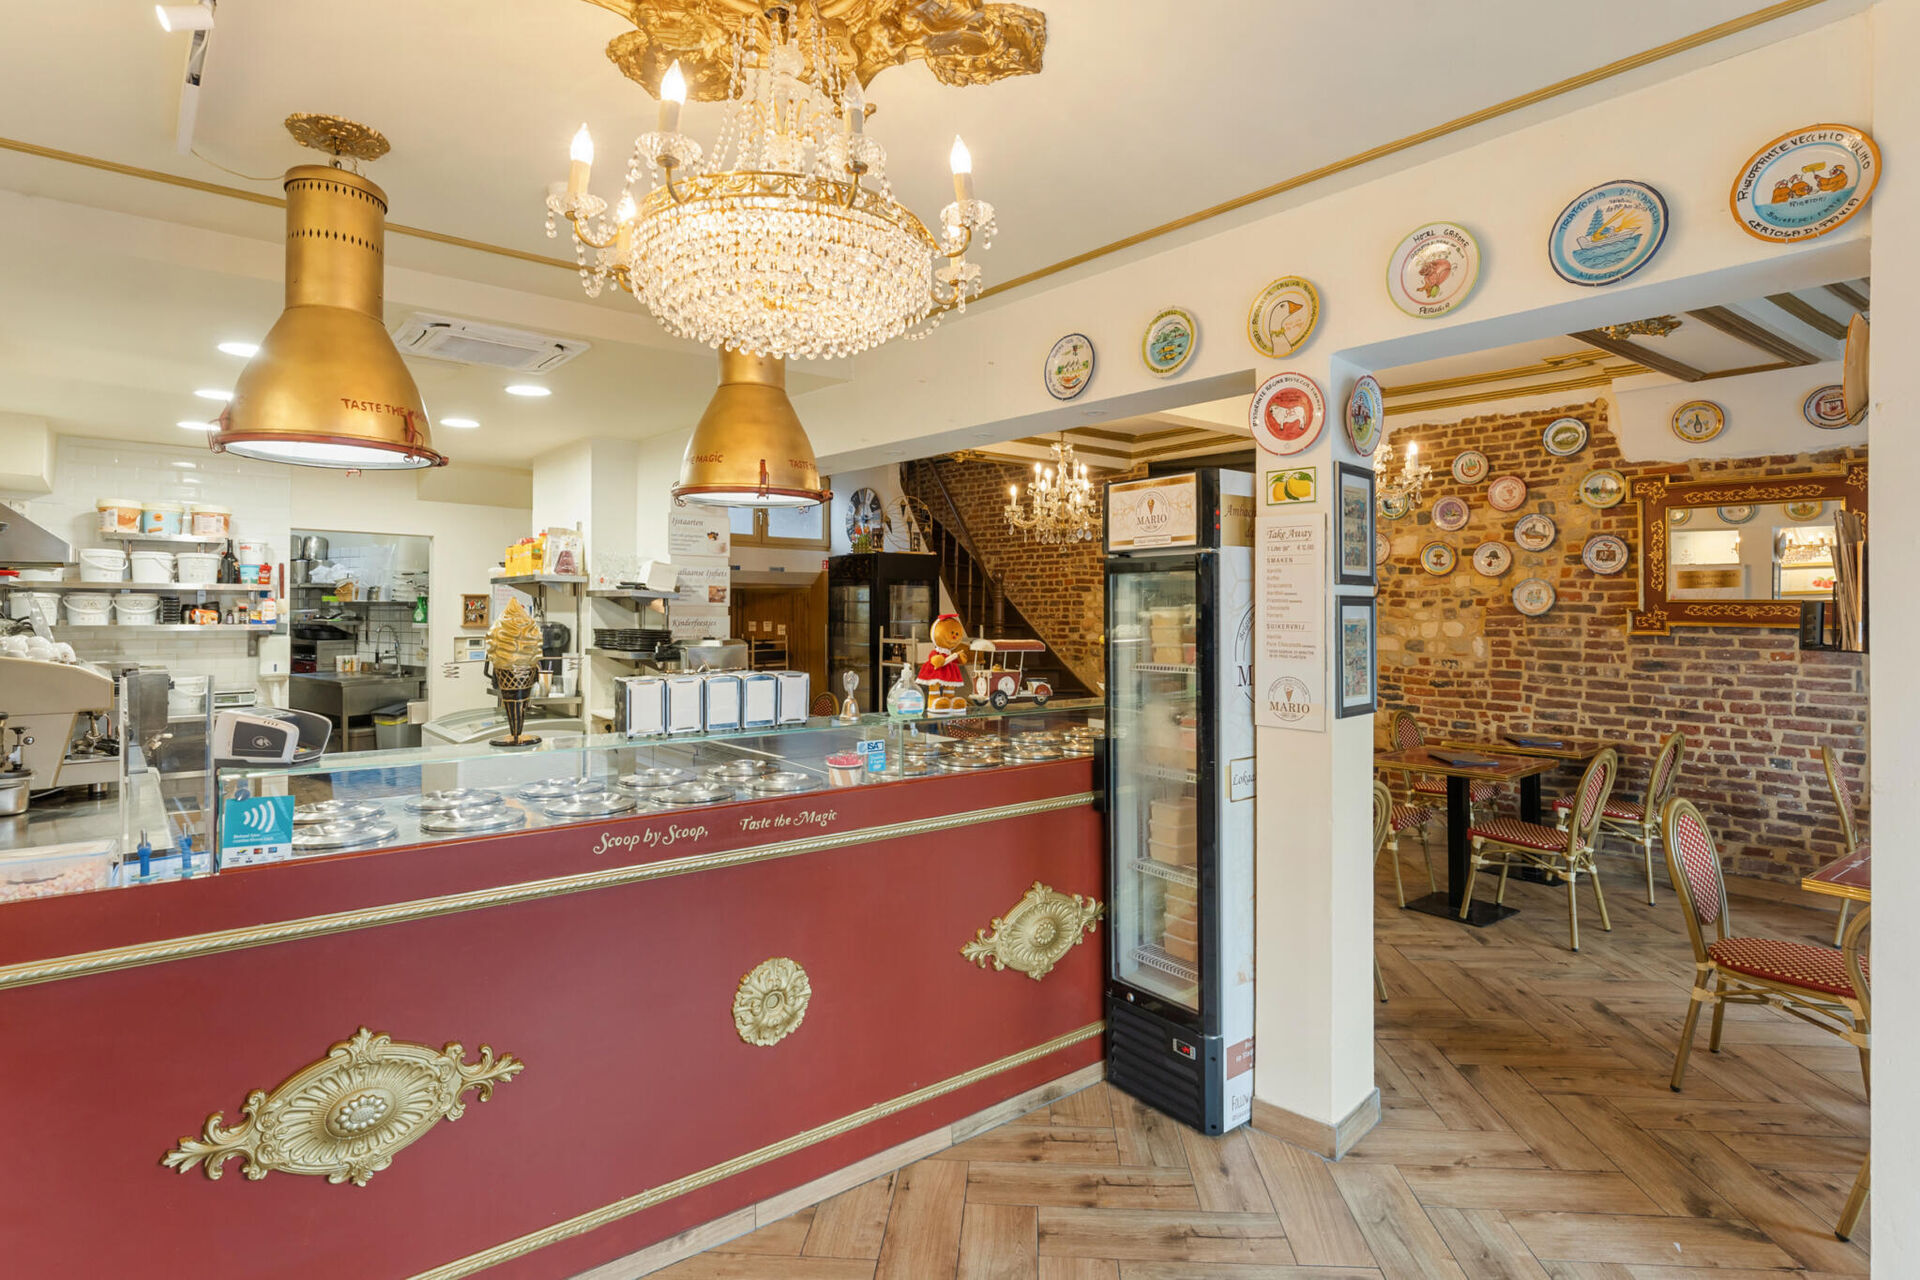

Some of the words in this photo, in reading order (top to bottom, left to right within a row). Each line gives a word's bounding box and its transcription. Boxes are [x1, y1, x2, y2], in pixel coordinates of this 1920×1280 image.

[1791, 132, 1844, 147] VECCHIO
[1748, 219, 1800, 238] CERTOSA
[1818, 197, 1861, 228] PAVIA
[341, 398, 382, 413] TASTE
[1136, 514, 1168, 526] MARIO
[1267, 528, 1286, 541] Take
[1286, 528, 1313, 541] Away
[1266, 623, 1306, 631] SUIKERVRIJ
[1269, 701, 1311, 714] MARIO
[739, 816, 772, 831] Taste
[774, 814, 791, 828] the
[793, 809, 838, 827] Magic
[593, 831, 640, 855] Scoop
[643, 828, 662, 848] by
[661, 824, 709, 846] Scoop,
